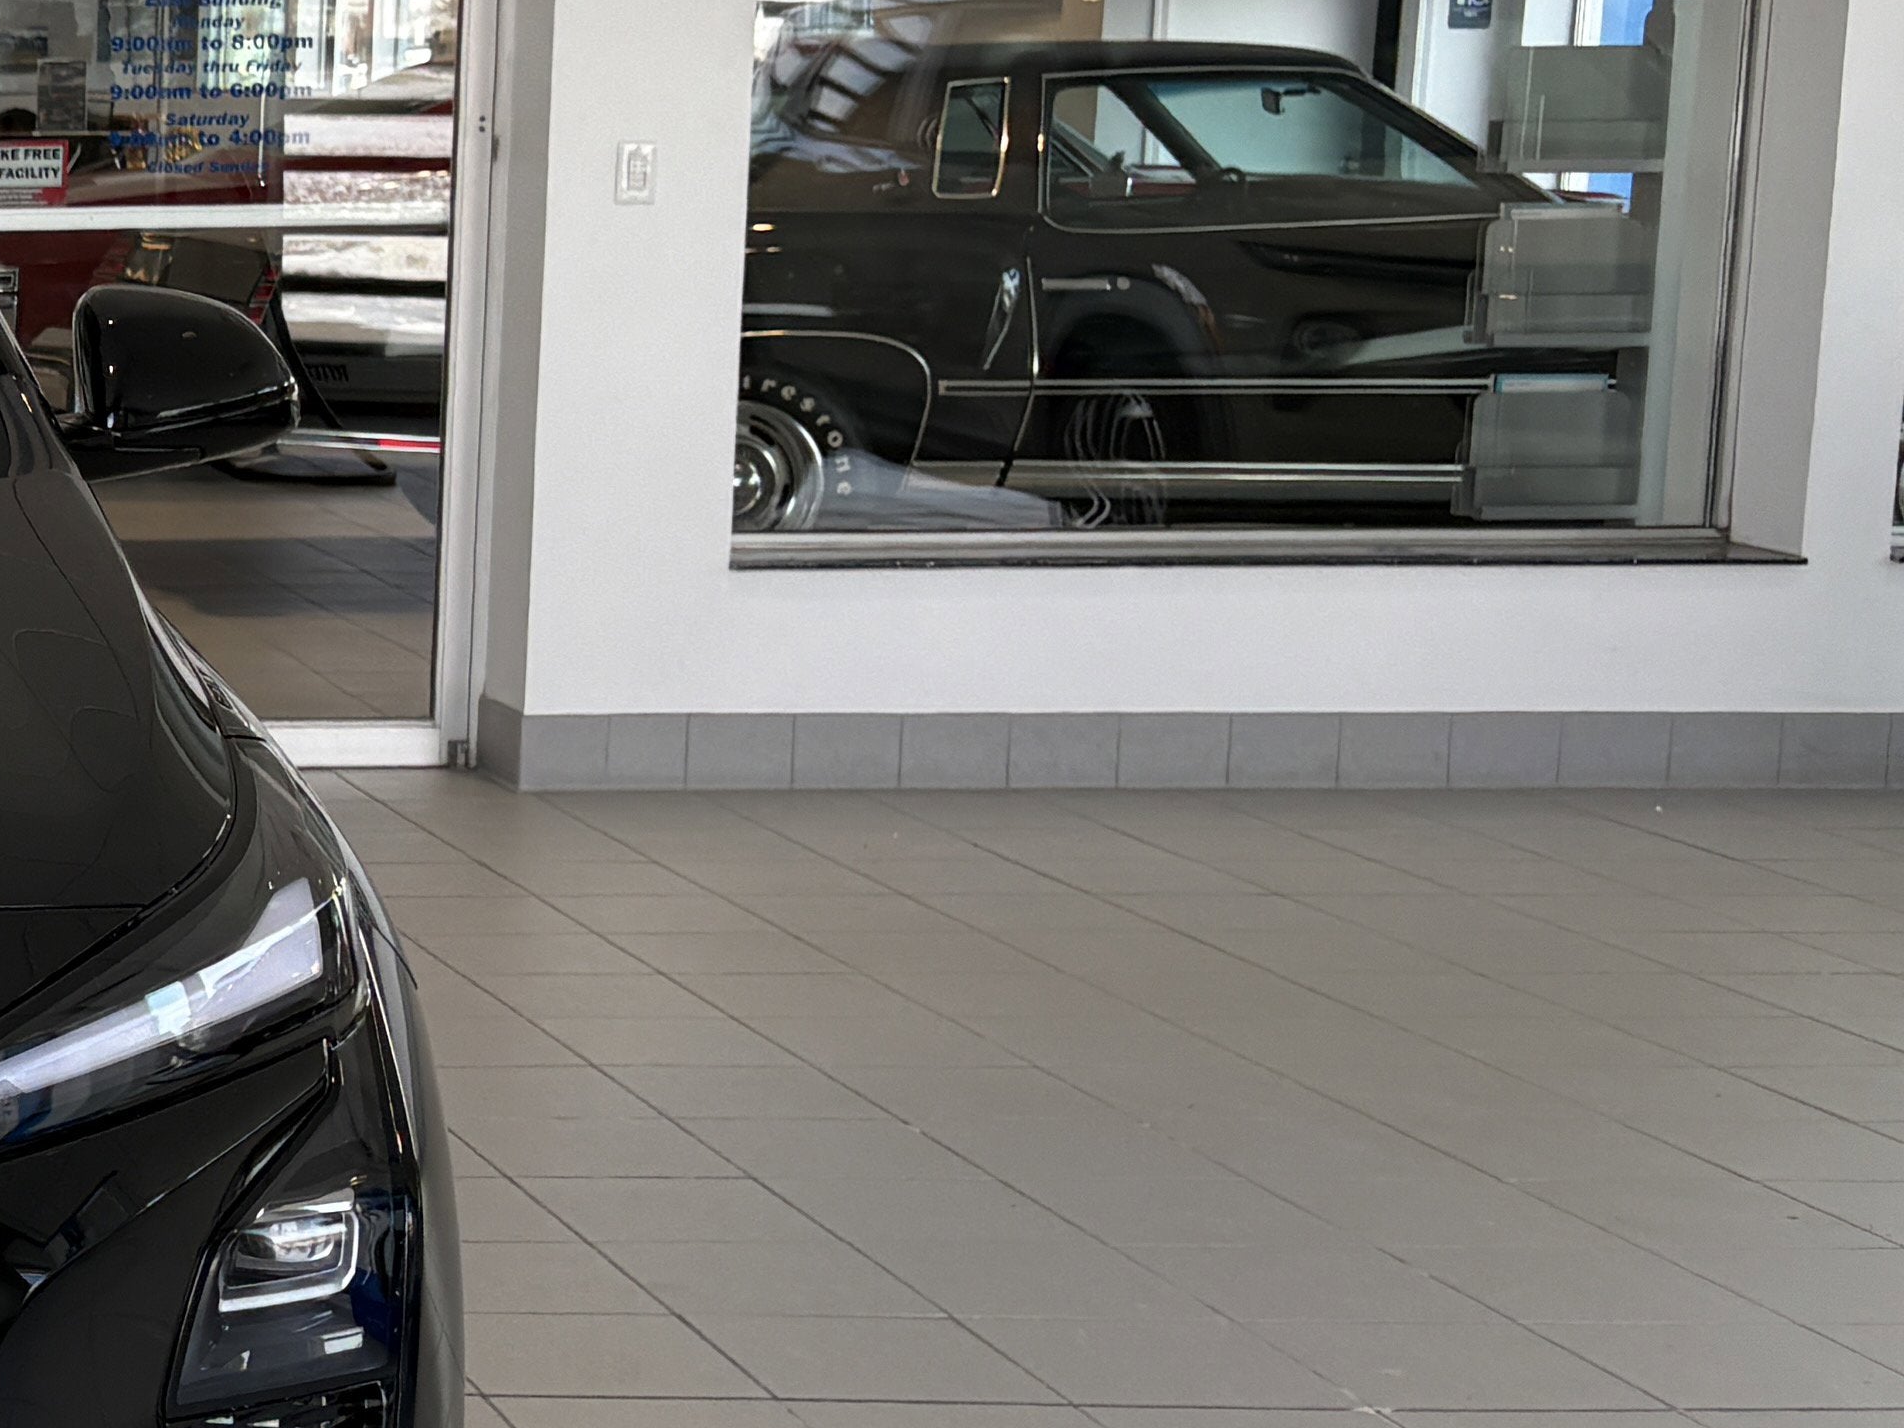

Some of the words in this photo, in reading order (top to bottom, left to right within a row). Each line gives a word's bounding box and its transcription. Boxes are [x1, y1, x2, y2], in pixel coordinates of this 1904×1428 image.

[201, 35, 223, 50] to
[232, 33, 313, 52] 8:00pm
[200, 85, 222, 100] to
[230, 82, 312, 100] 6:00pm
[166, 112, 250, 128] Saturday
[199, 130, 220, 146] to
[229, 128, 310, 147] 4:00pm
[24, 148, 60, 161] FREE
[742, 374, 853, 496] irestone
